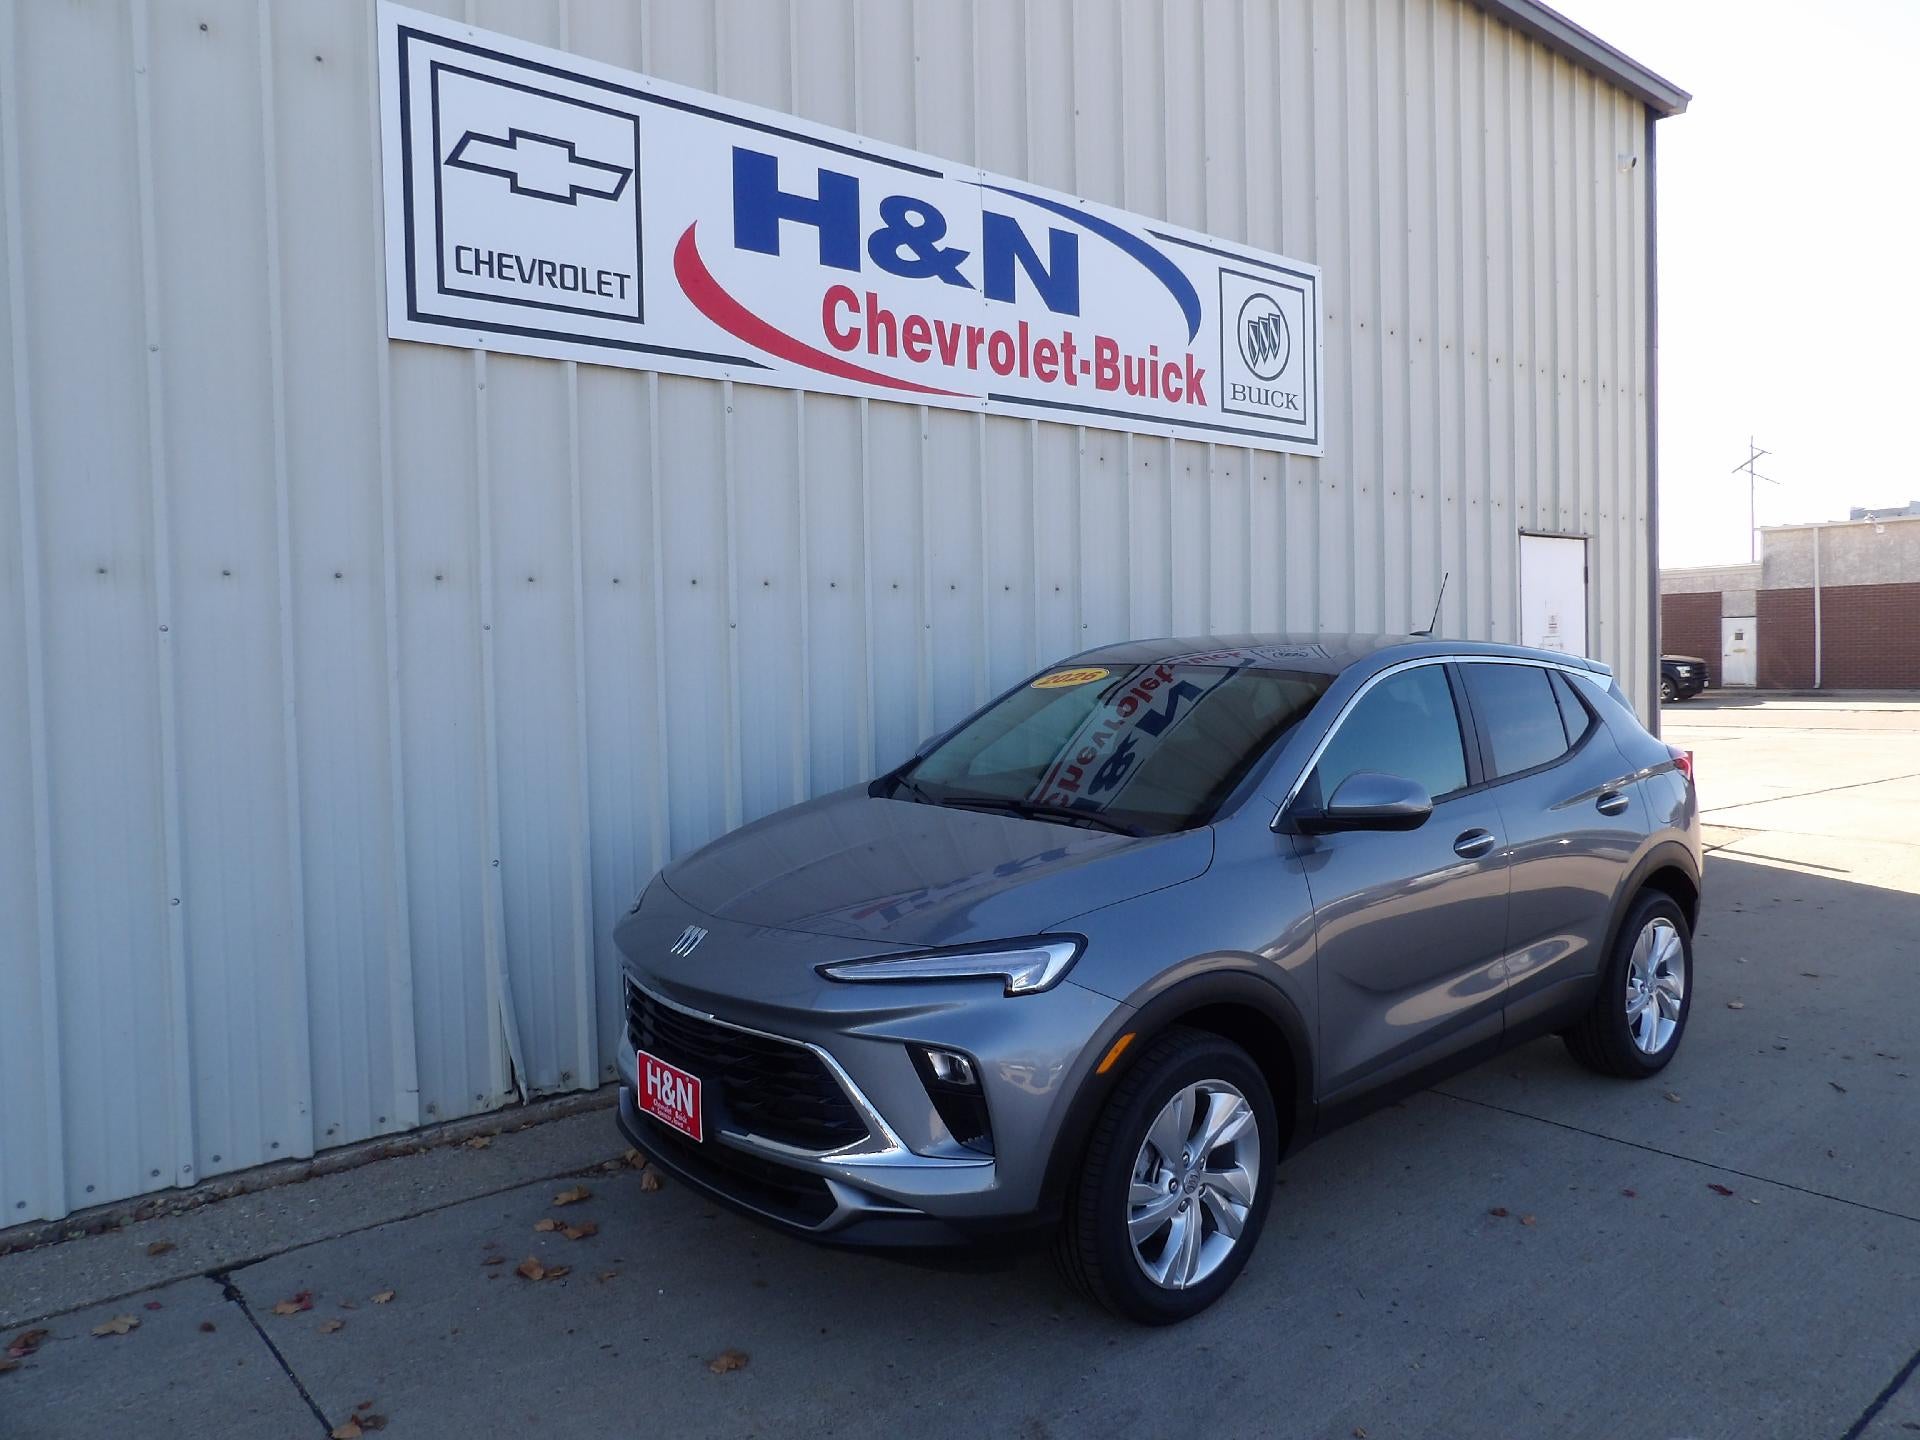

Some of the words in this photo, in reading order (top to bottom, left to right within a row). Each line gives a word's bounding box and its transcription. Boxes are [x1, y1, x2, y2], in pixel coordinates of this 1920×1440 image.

[733, 147, 1080, 316] H&N
[455, 245, 631, 300] CHEVROLET
[822, 285, 1207, 407] Chevrolet-Buick
[1230, 382, 1299, 411] BUICK
[1037, 671, 1103, 685] 2026
[646, 1061, 693, 1118] H&N
